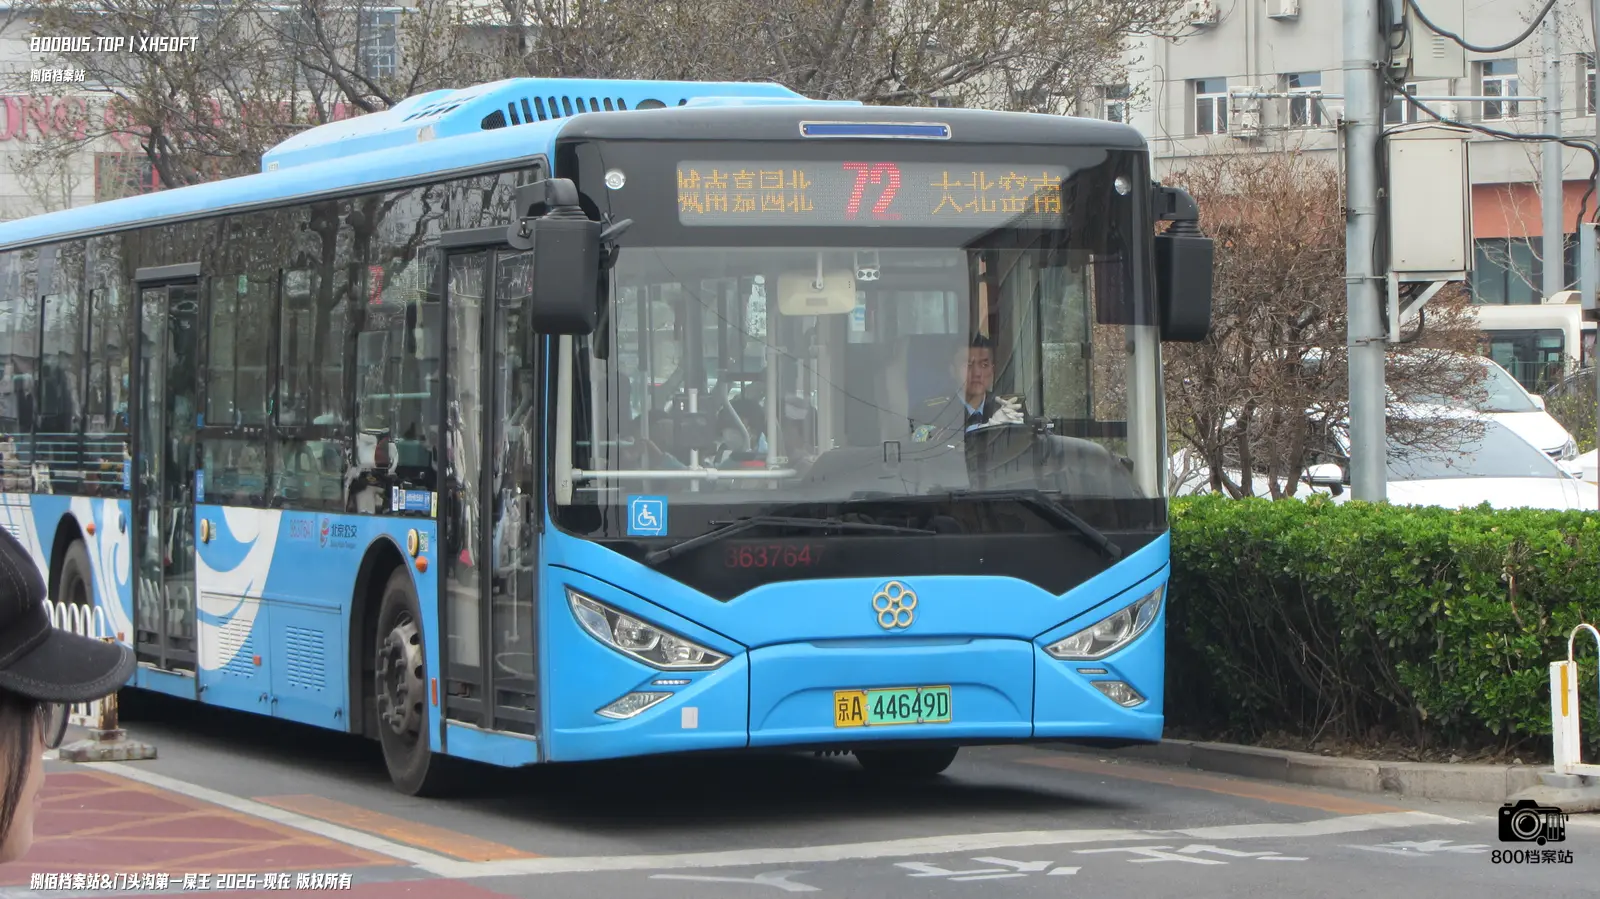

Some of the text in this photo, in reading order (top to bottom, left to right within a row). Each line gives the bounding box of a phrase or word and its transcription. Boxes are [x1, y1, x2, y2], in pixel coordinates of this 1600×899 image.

[843, 162, 902, 220] 72
[930, 171, 1062, 214] 大北窑南
[331, 523, 358, 538] 北京公交
[724, 543, 827, 568] 3637647
[837, 692, 949, 722] 京A 44649D
